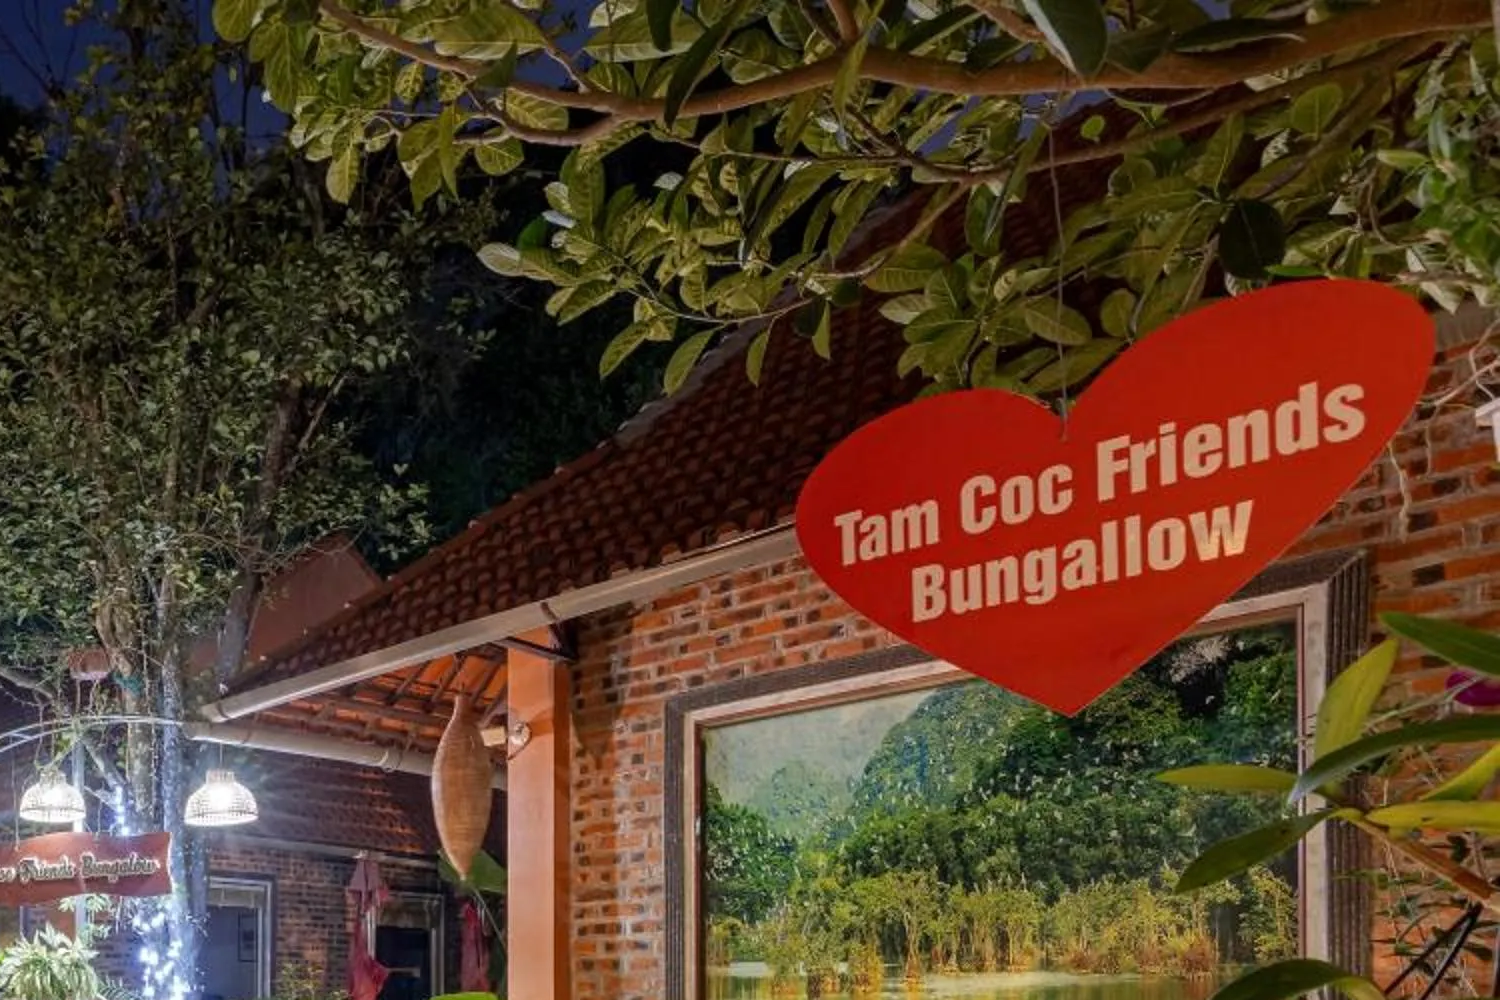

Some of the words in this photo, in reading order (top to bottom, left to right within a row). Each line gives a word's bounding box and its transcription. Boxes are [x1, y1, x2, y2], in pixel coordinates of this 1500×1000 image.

[834, 499, 940, 568] Tam
[959, 463, 1074, 536] Coc
[1096, 380, 1367, 503] Friends
[911, 499, 1254, 624] Bungallow
